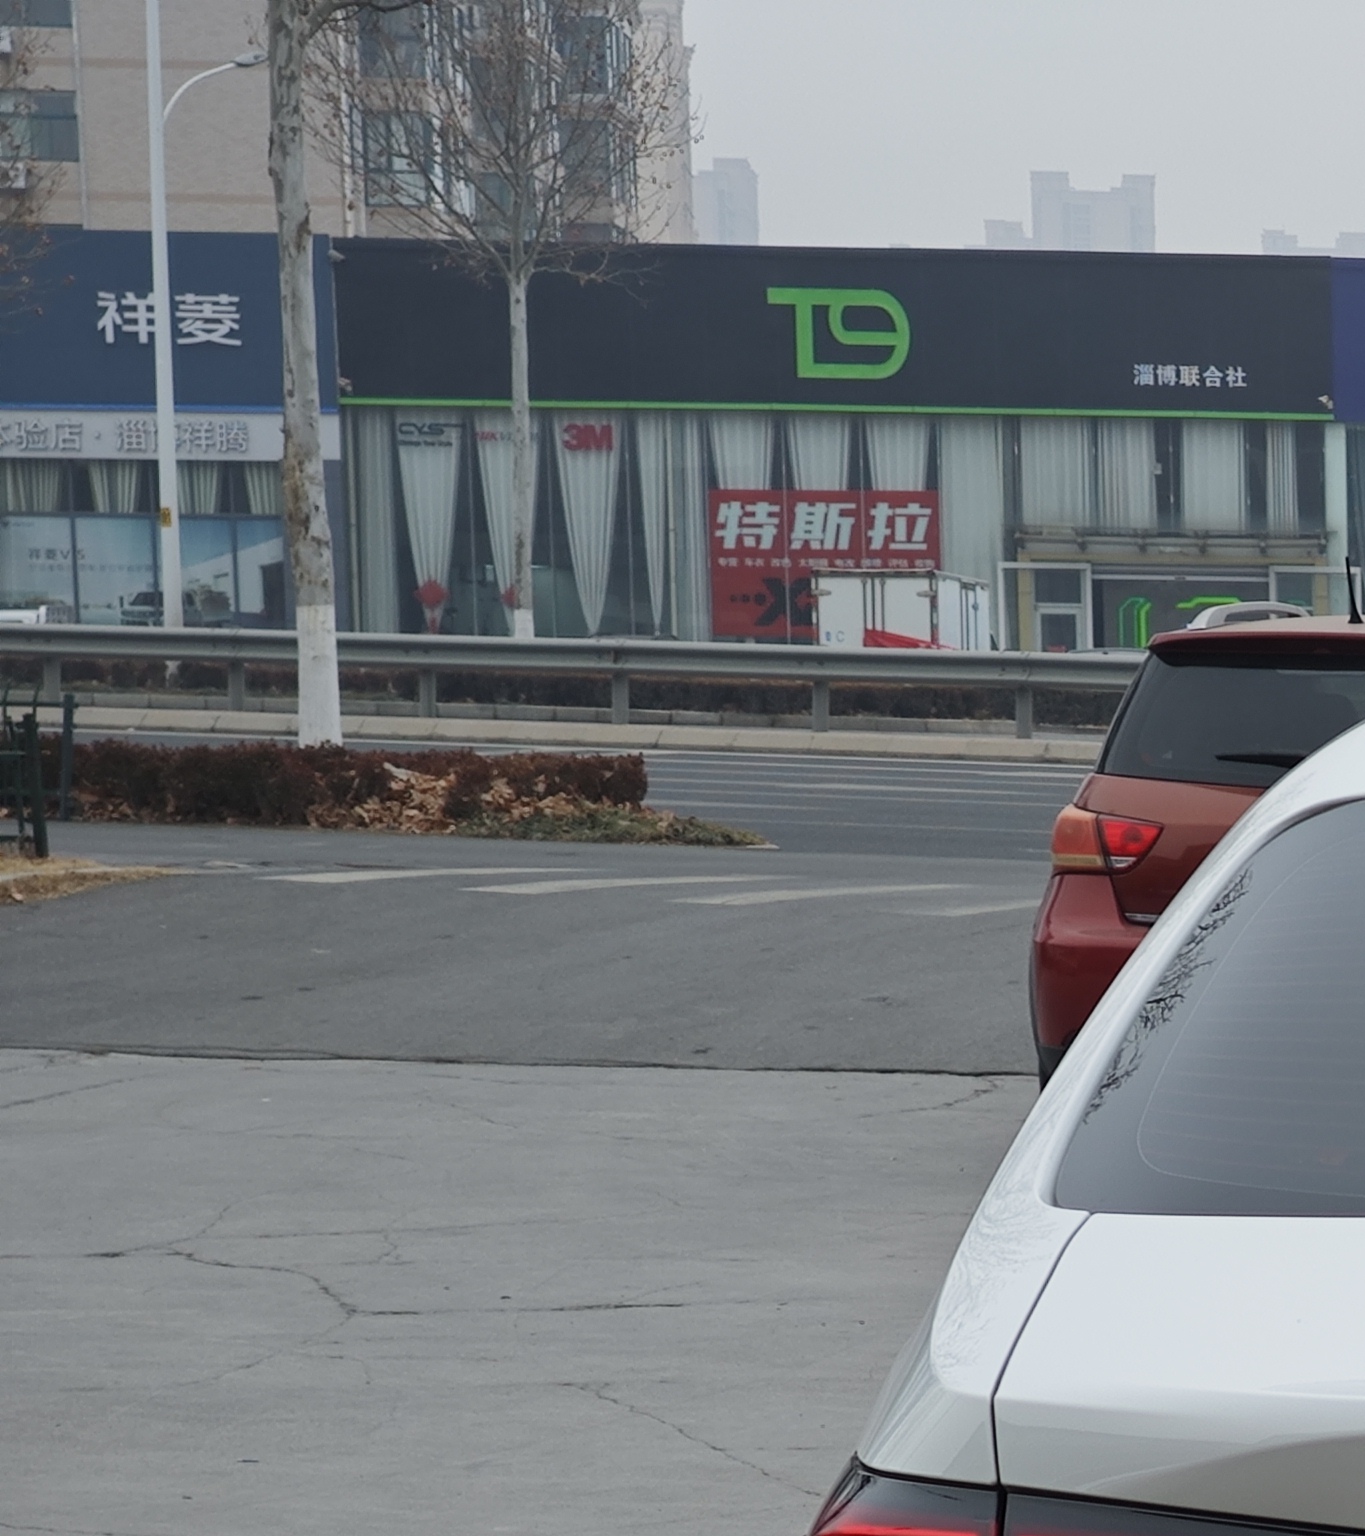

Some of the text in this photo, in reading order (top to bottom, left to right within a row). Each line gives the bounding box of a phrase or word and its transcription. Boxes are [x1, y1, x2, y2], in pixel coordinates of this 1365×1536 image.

[97, 292, 242, 346] 祥菱
[1133, 364, 1247, 388] 淄博联合社
[562, 424, 613, 450] 3M
[715, 501, 932, 550] 特斯拉
